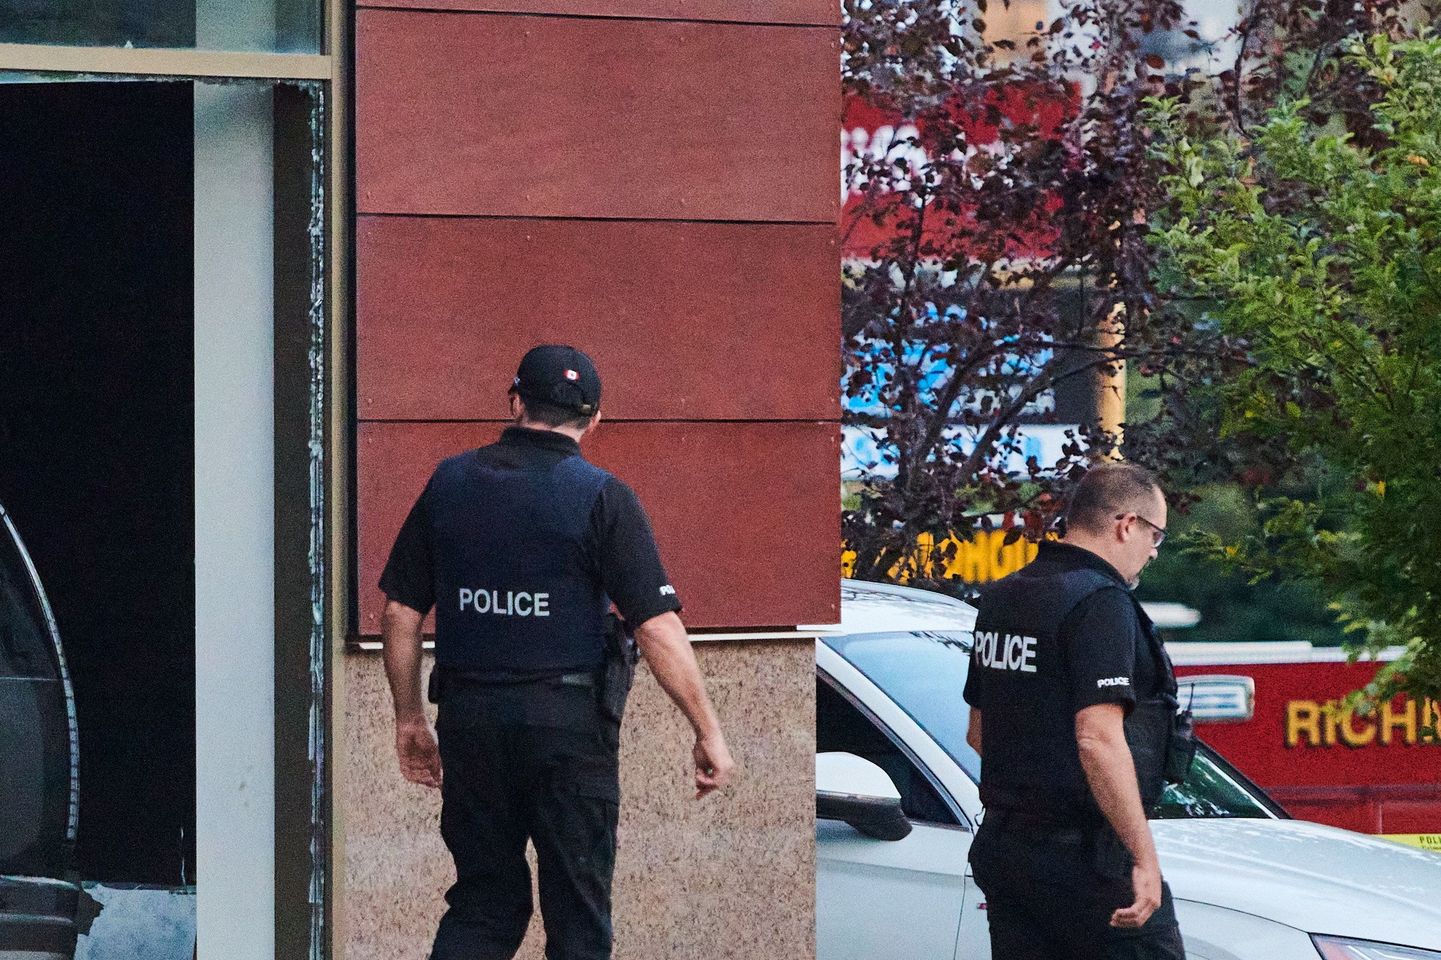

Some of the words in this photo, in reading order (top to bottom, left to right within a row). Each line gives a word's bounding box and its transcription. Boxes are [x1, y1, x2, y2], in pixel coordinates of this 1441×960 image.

[459, 588, 550, 617] POLICE
[975, 631, 1037, 673] POLICE
[1097, 676, 1130, 688] POLICE
